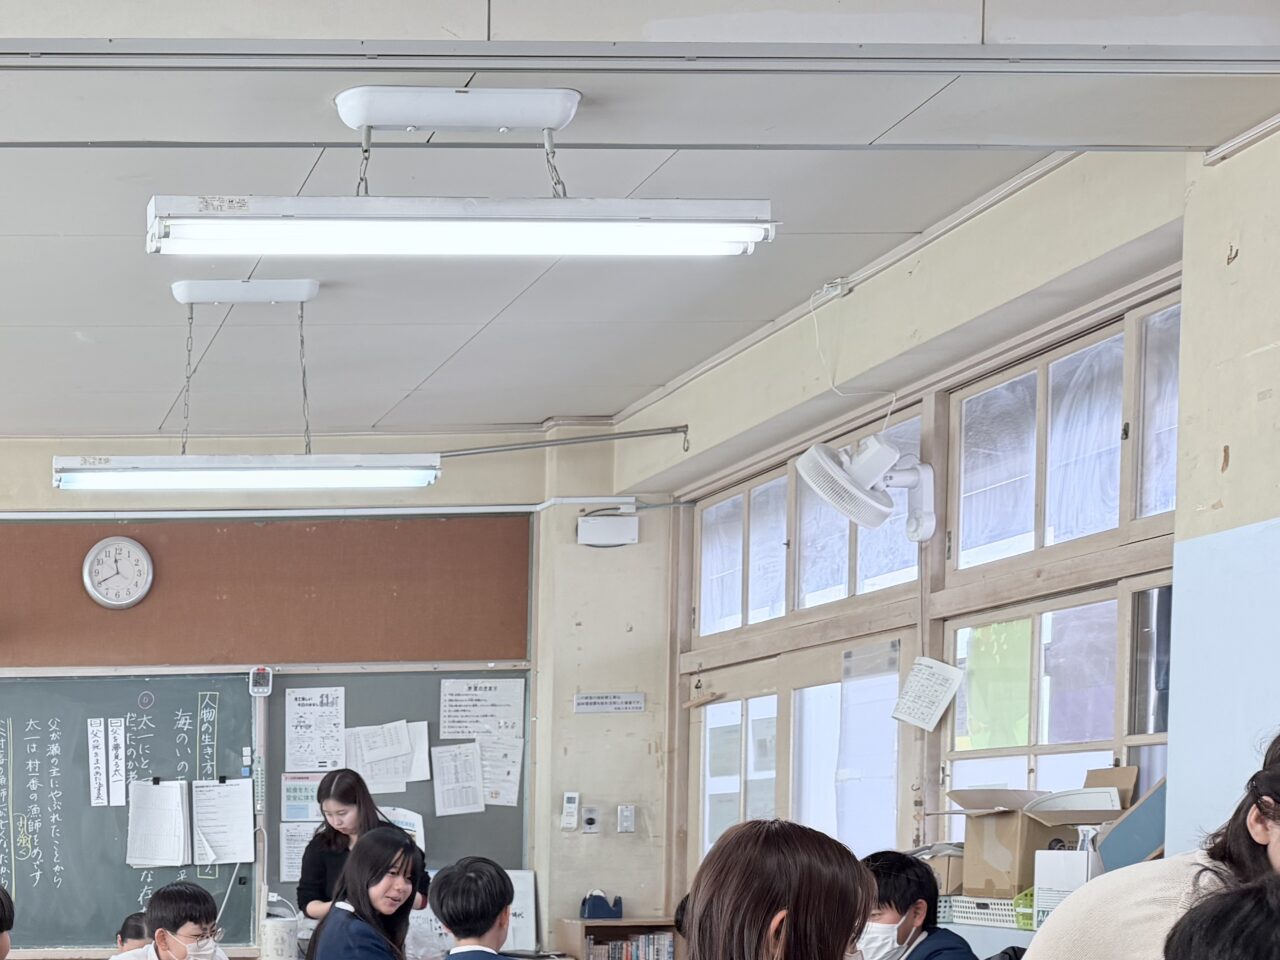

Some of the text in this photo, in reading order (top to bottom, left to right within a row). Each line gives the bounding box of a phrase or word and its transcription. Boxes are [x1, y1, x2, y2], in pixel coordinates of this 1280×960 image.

[94, 569, 99, 577] 9
[136, 569, 142, 577] 3
[137, 714, 155, 782] 太一にとっ
[173, 708, 193, 781] 海のいの
